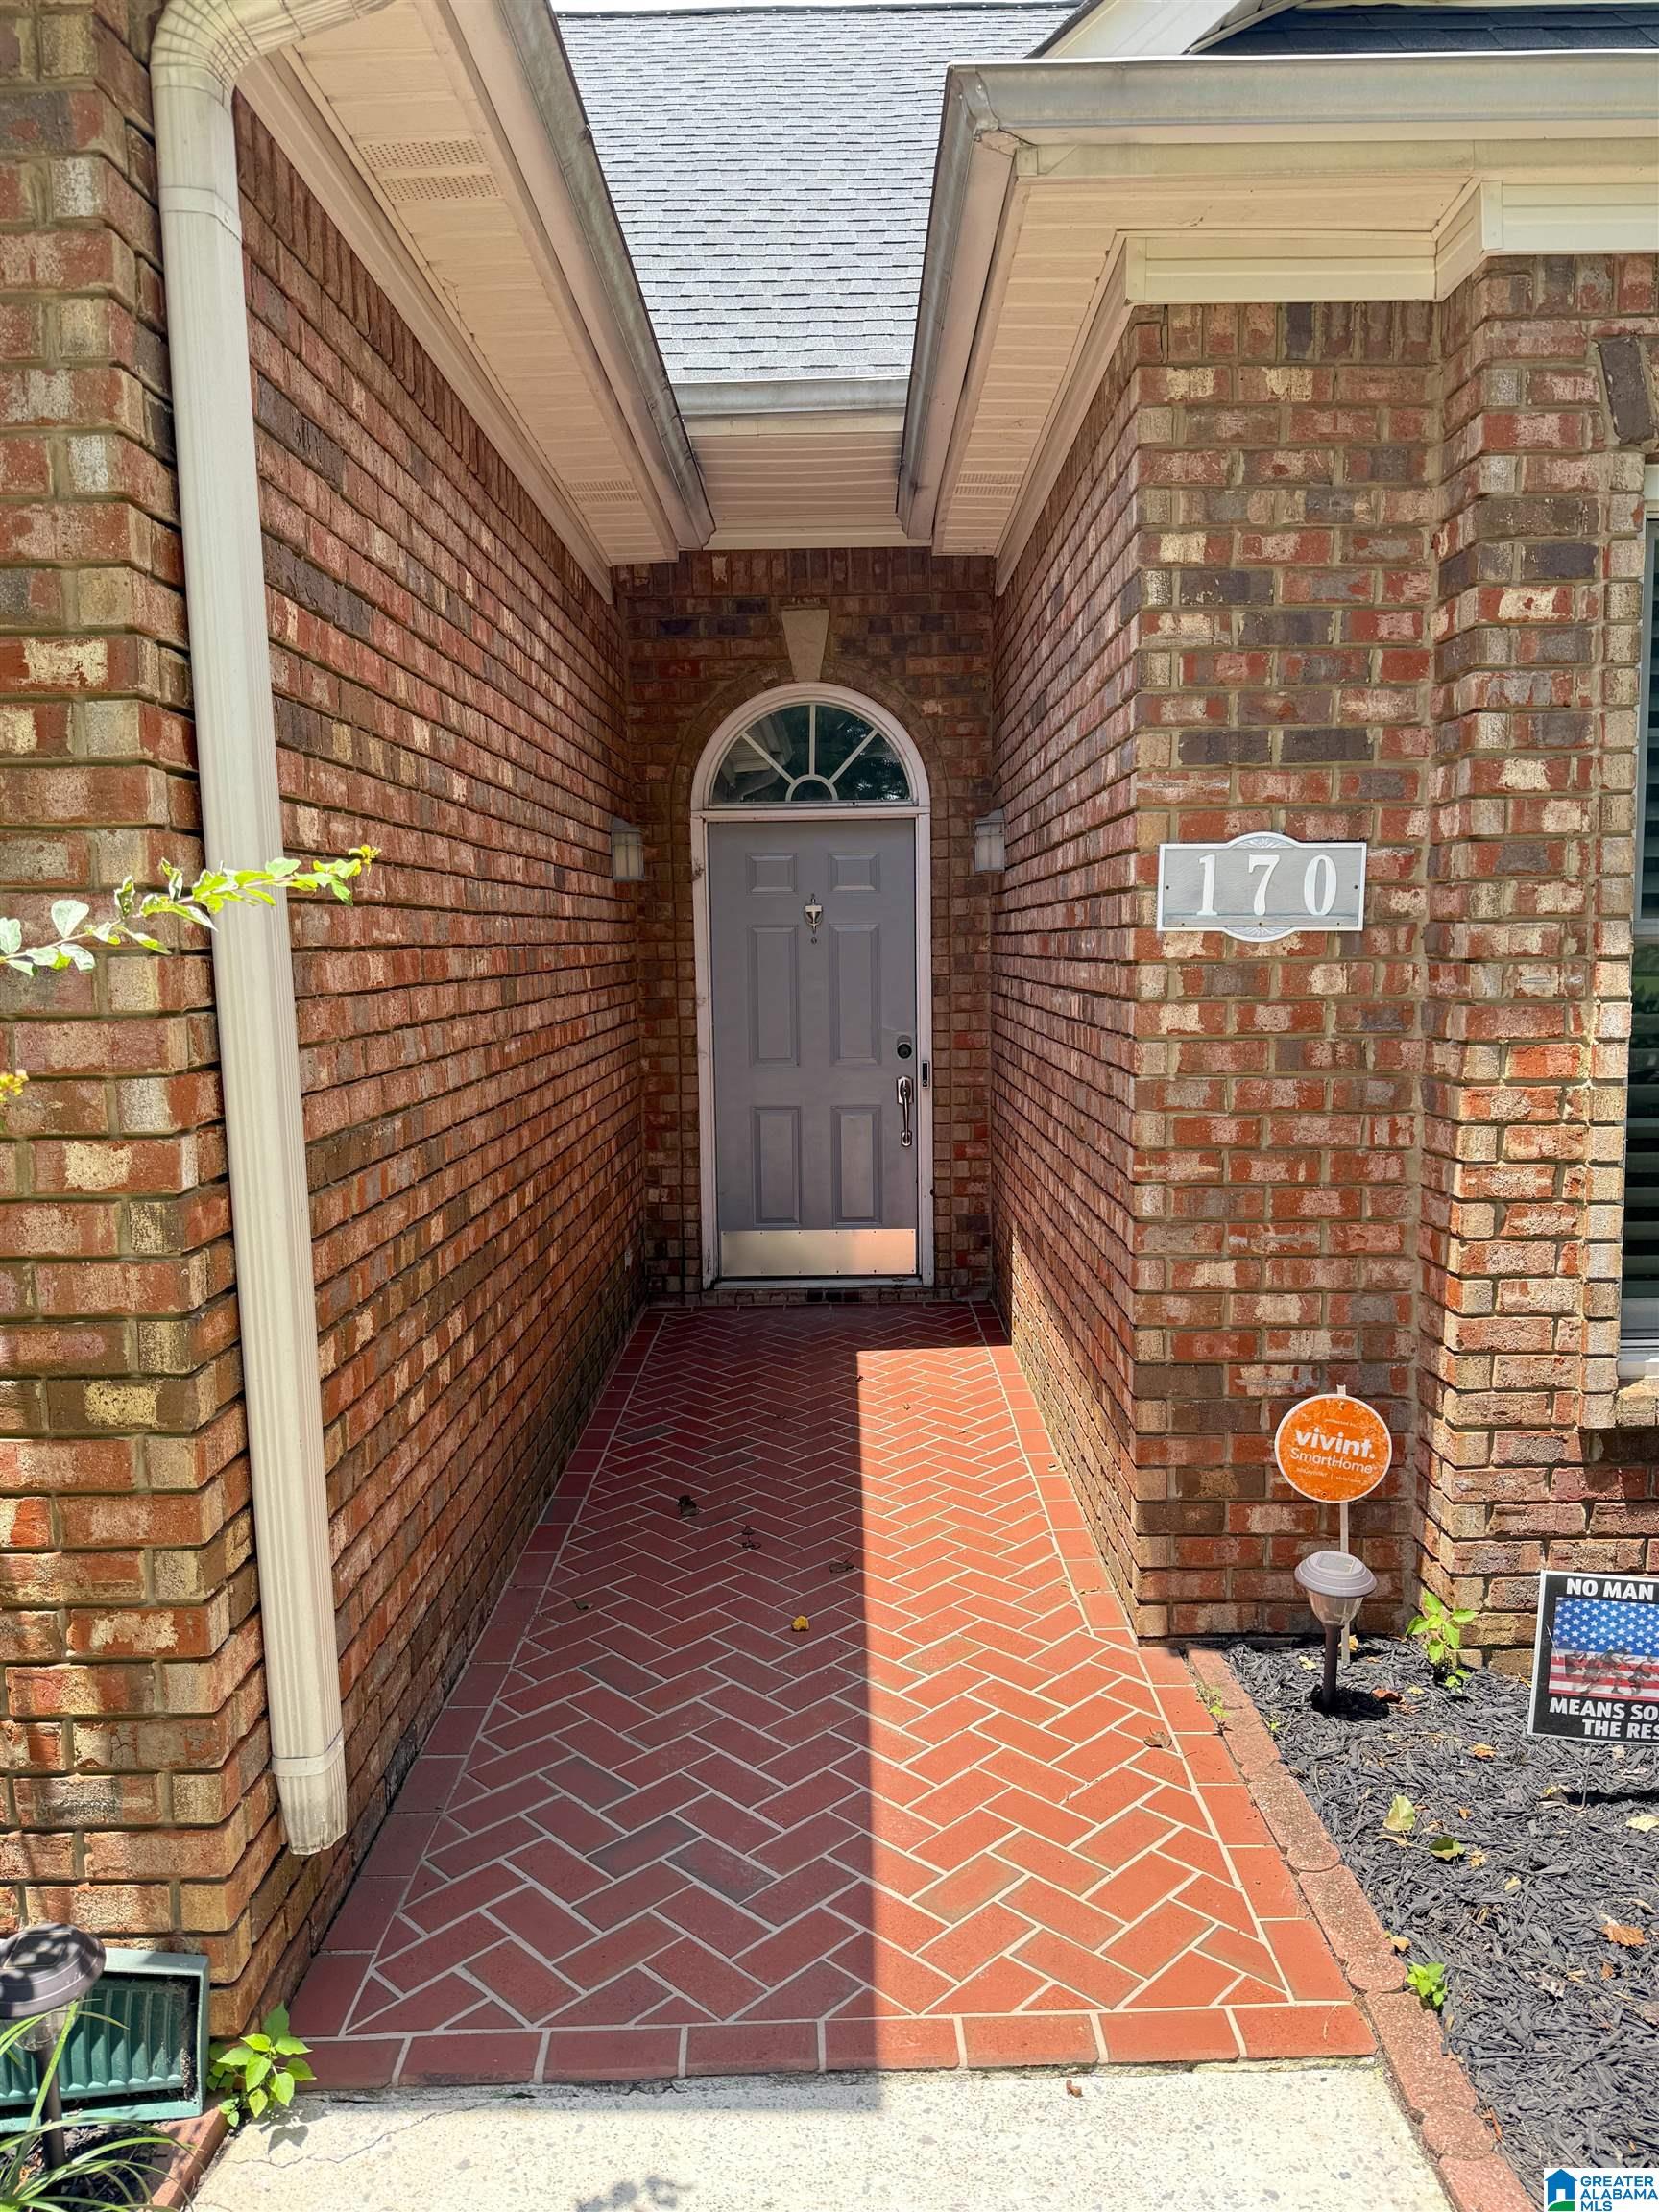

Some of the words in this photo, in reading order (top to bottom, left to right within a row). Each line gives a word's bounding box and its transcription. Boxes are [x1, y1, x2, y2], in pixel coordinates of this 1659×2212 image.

[1196, 854, 1337, 916] 170
[1289, 1448, 1373, 1475] SmartHome
[1566, 1577, 1599, 1597] NO
[1602, 1580, 1654, 1601] MAN
[1549, 1696, 1625, 1719] MEANS
[1629, 1704, 1659, 1721] SO
[1582, 1719, 1622, 1738] THE
